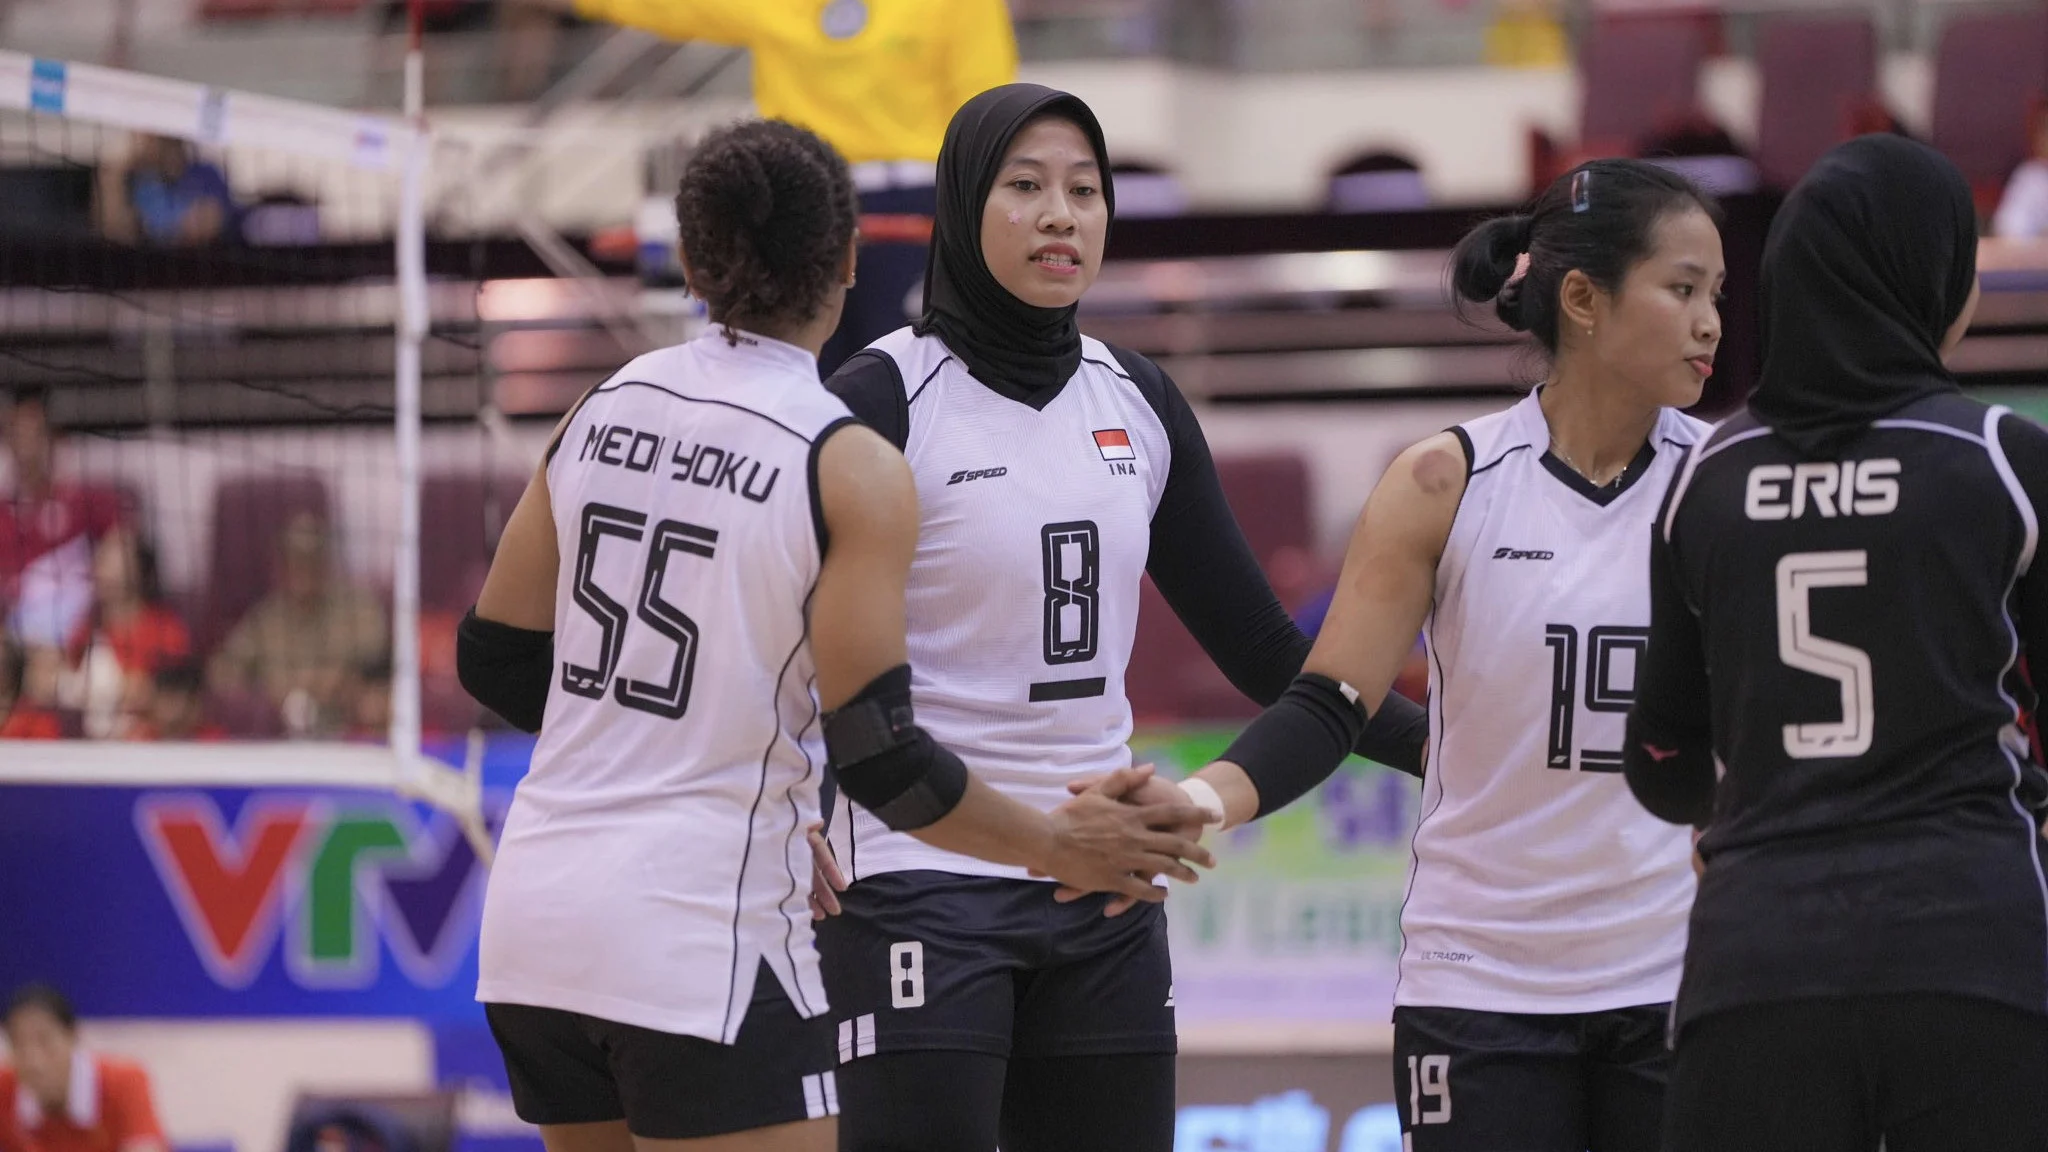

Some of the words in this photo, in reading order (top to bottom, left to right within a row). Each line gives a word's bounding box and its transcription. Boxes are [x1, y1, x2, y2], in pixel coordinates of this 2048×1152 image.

[671, 440, 780, 503] YOKU
[1109, 463, 1136, 476] INA
[1745, 458, 1901, 520] ERIS
[561, 502, 719, 720] 55
[1041, 520, 1100, 665] 8
[1775, 549, 1874, 759] 5
[1545, 623, 1651, 773] 19
[890, 941, 925, 1009] 8
[1421, 950, 1474, 962] ULTRADRY
[1408, 1055, 1452, 1126] 19
